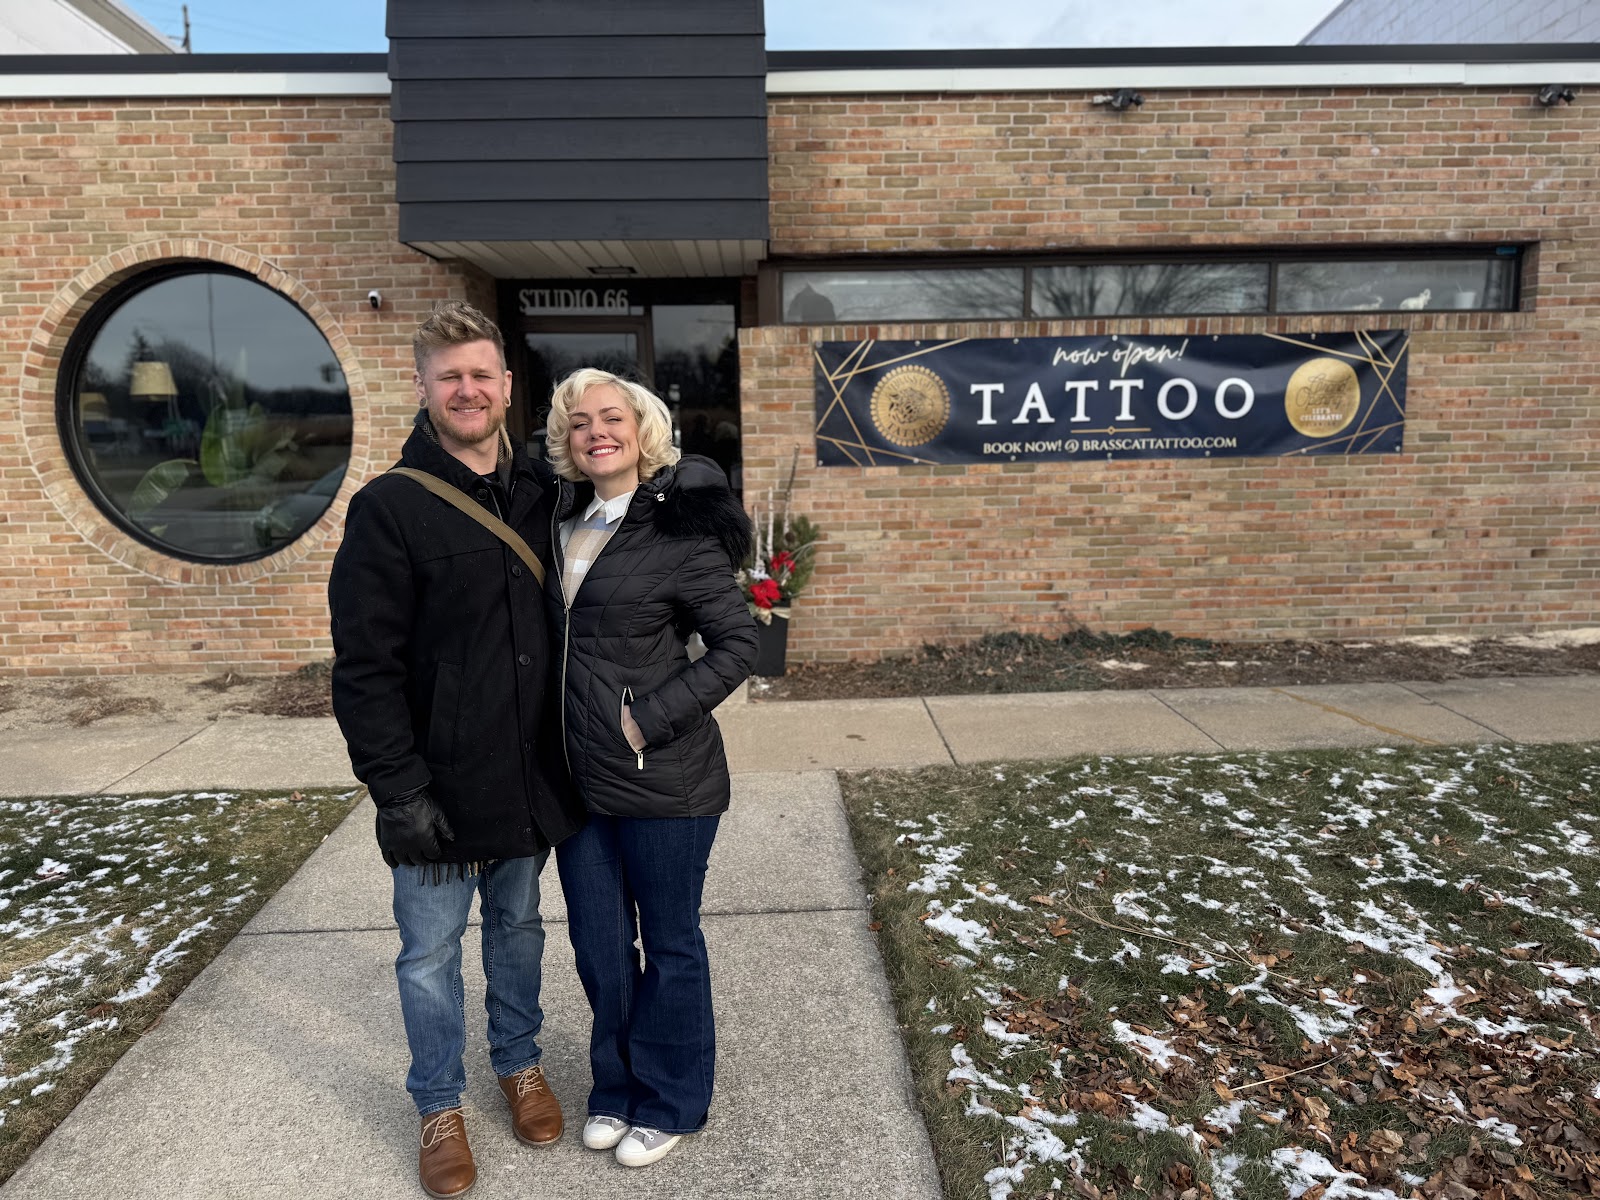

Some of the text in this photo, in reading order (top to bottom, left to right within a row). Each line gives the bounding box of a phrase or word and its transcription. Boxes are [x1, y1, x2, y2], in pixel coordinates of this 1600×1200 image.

[519, 289, 629, 313] STUDIO 66
[1052, 338, 1189, 378] now open!
[970, 377, 1255, 425] TATTOO
[1300, 413, 1342, 421] CELEBRATE!
[887, 419, 936, 438] TATTOO
[983, 437, 1237, 454] BOOK NOW! @ BRASSCATTATTOO.COM
